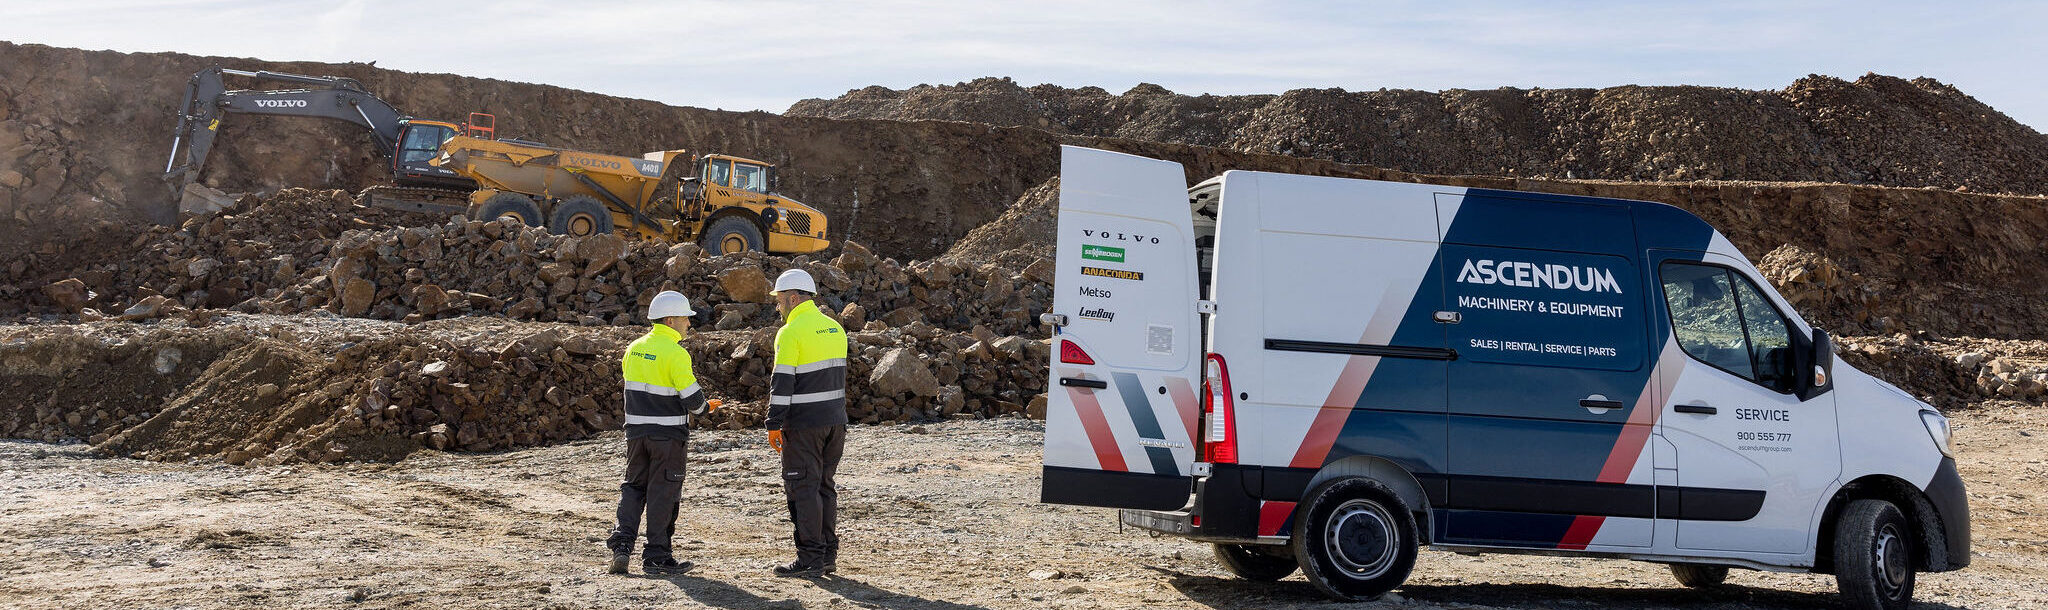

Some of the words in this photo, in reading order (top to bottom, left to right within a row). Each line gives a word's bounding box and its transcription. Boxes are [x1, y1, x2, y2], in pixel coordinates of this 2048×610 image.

[254, 99, 307, 108] VOLVO
[568, 156, 621, 170] VOLVO
[641, 162, 659, 174] A40D
[1082, 229, 1160, 245] VOLVO
[1083, 267, 1140, 280] ANACONDA
[1456, 258, 1623, 294] ASCENDUM
[1079, 286, 1112, 299] Metso
[1458, 295, 1535, 312] MACHINERY
[1538, 301, 1548, 313] &
[1550, 302, 1624, 318] EQUIPMENT
[1079, 306, 1115, 323] LeeBoy
[1470, 338, 1499, 349] SALES
[1505, 341, 1539, 352] RENTAL
[1545, 343, 1582, 355] SERVICE
[1588, 346, 1617, 357] PARTS
[1735, 408, 1790, 422] SERVICE
[1737, 431, 1756, 441] 900
[1757, 432, 1775, 442] 555
[1776, 432, 1792, 442] 777
